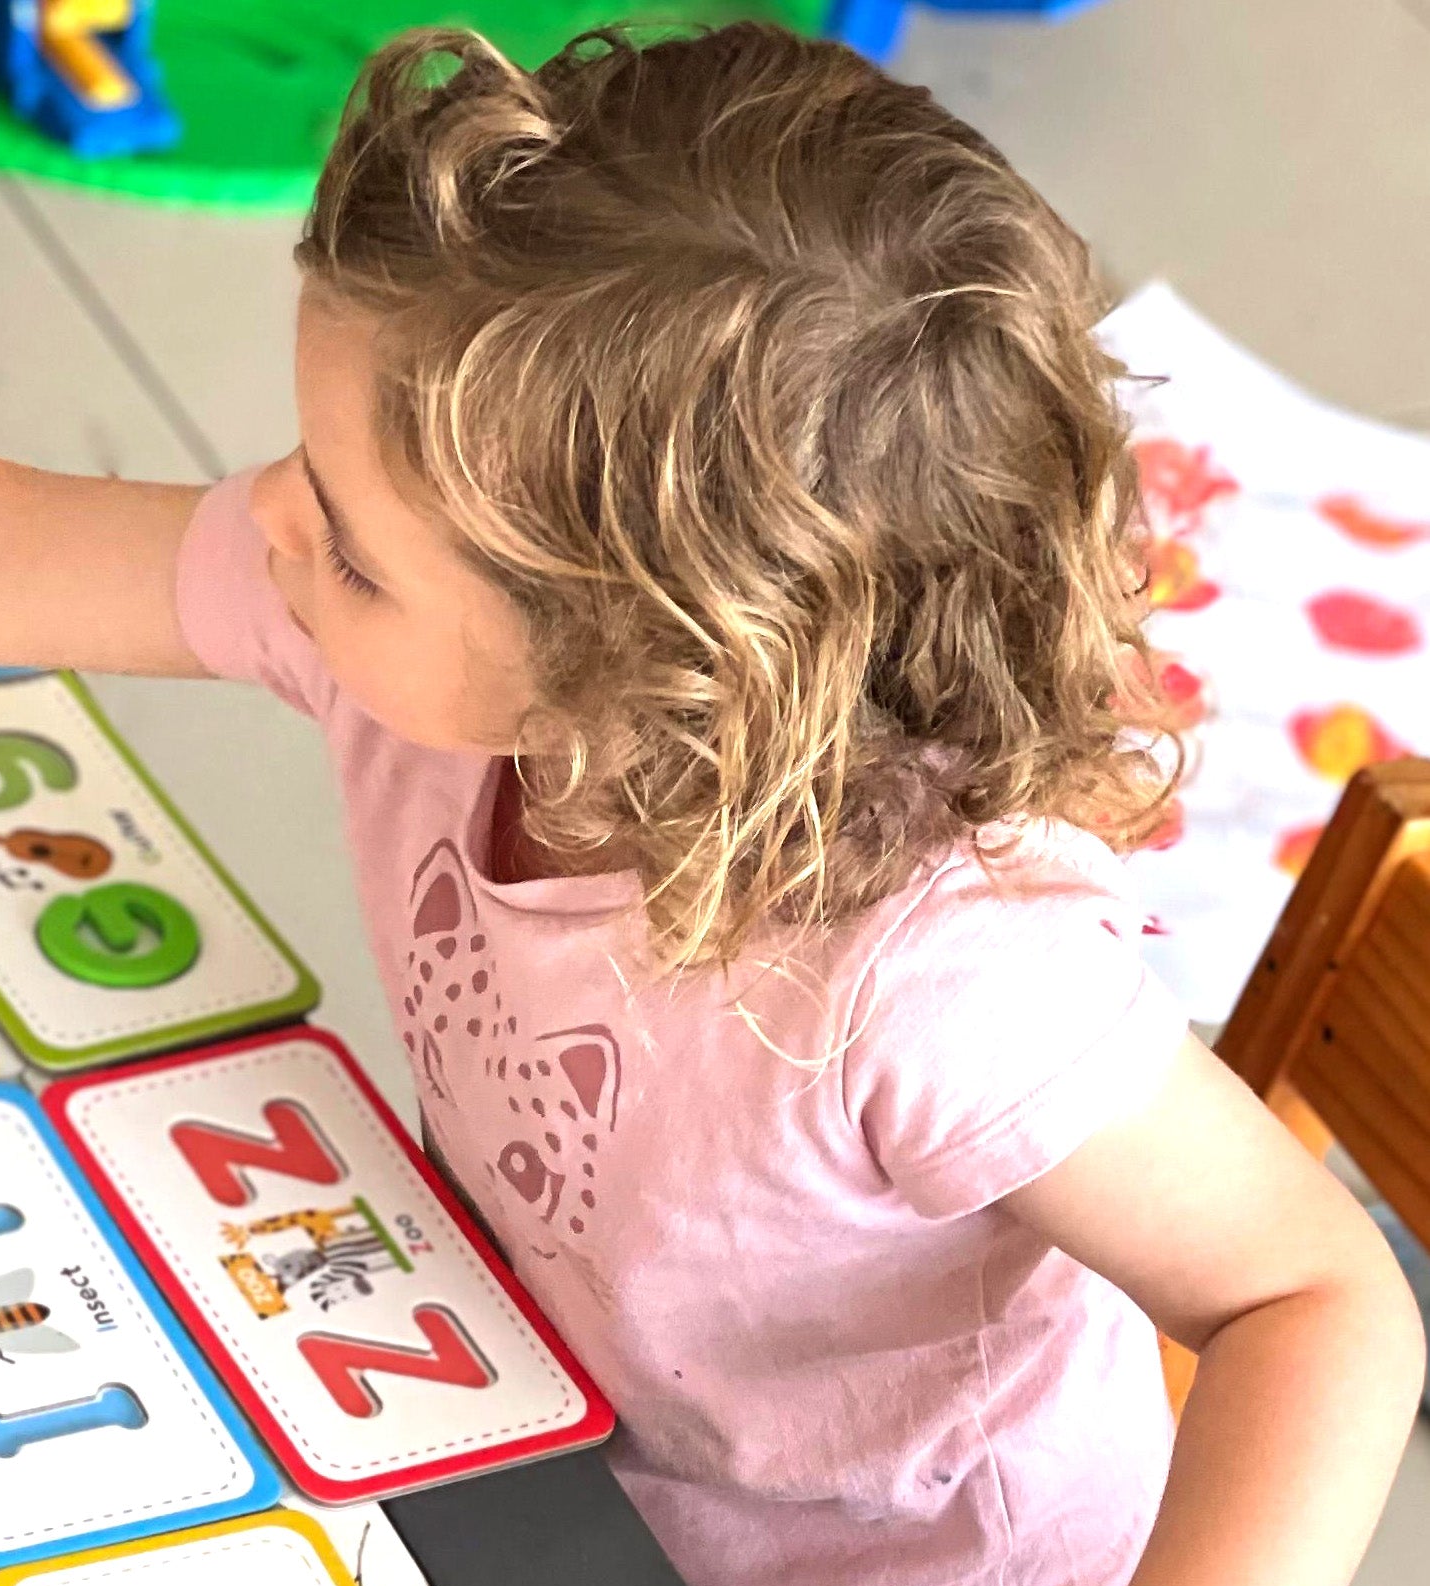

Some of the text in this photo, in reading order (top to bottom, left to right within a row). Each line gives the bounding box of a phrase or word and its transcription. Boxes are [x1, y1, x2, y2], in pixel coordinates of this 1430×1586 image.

[36, 880, 200, 989] G
[395, 1214, 434, 1256] Zoo
[60, 1264, 120, 1334] Insect
